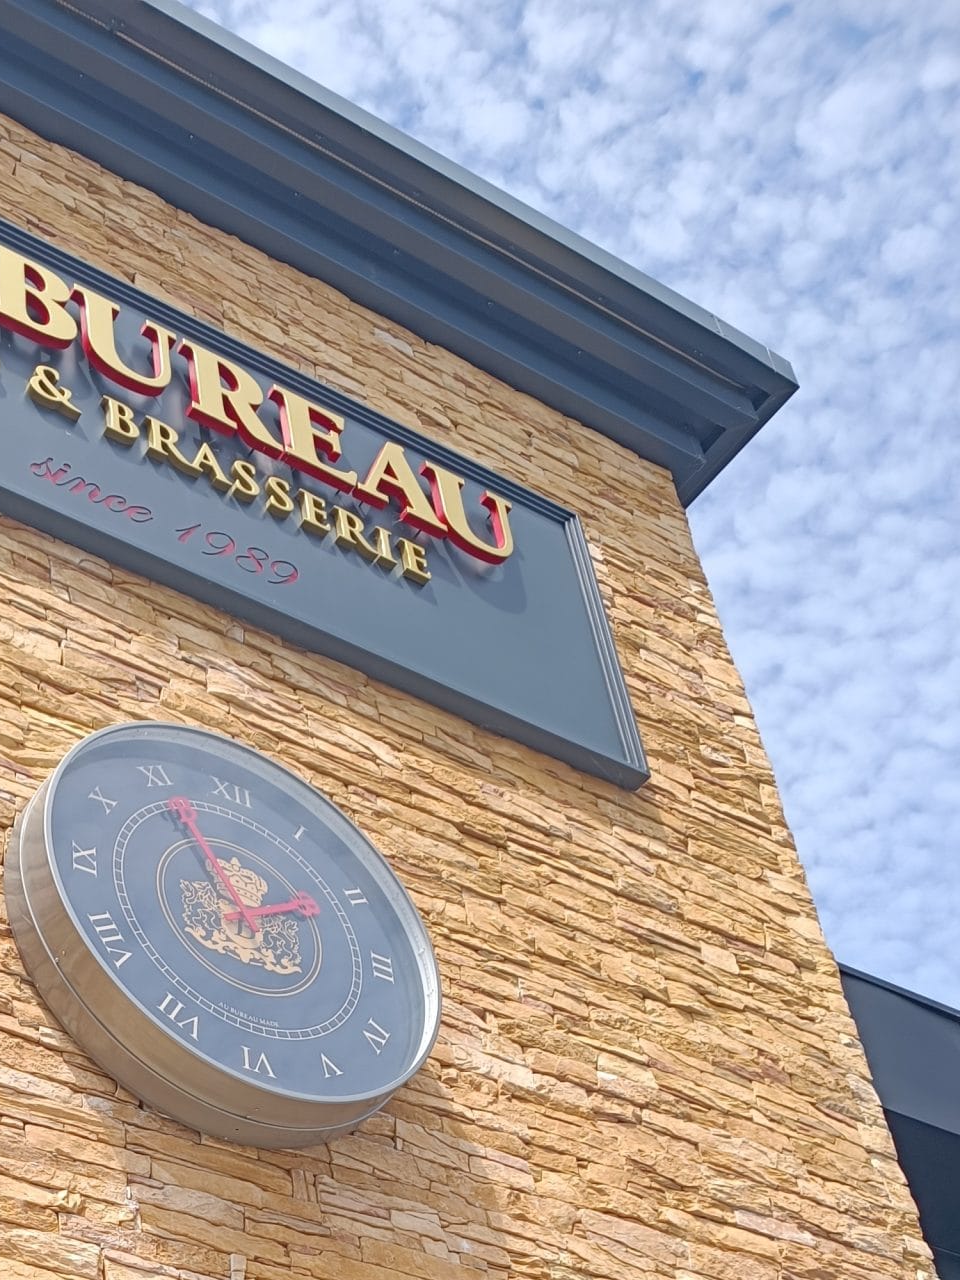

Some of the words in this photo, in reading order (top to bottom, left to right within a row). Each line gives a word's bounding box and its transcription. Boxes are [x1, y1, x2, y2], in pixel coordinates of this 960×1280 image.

[28, 364, 82, 423] &
[100, 394, 434, 585] BRASSERIE
[30, 457, 154, 523] since
[175, 523, 300, 585] 1989
[136, 765, 174, 787] XI
[211, 776, 252, 809] XII
[88, 786, 118, 815] X
[293, 824, 309, 841] I
[72, 840, 97, 878] IX
[343, 887, 369, 906] II
[87, 911, 133, 970] VIII
[370, 950, 395, 985] III
[157, 991, 200, 1041] VII
[230, 1007, 258, 1023] BUREAU
[362, 1018, 391, 1055] IV
[241, 1045, 278, 1079] VI
[320, 1052, 344, 1079] V
